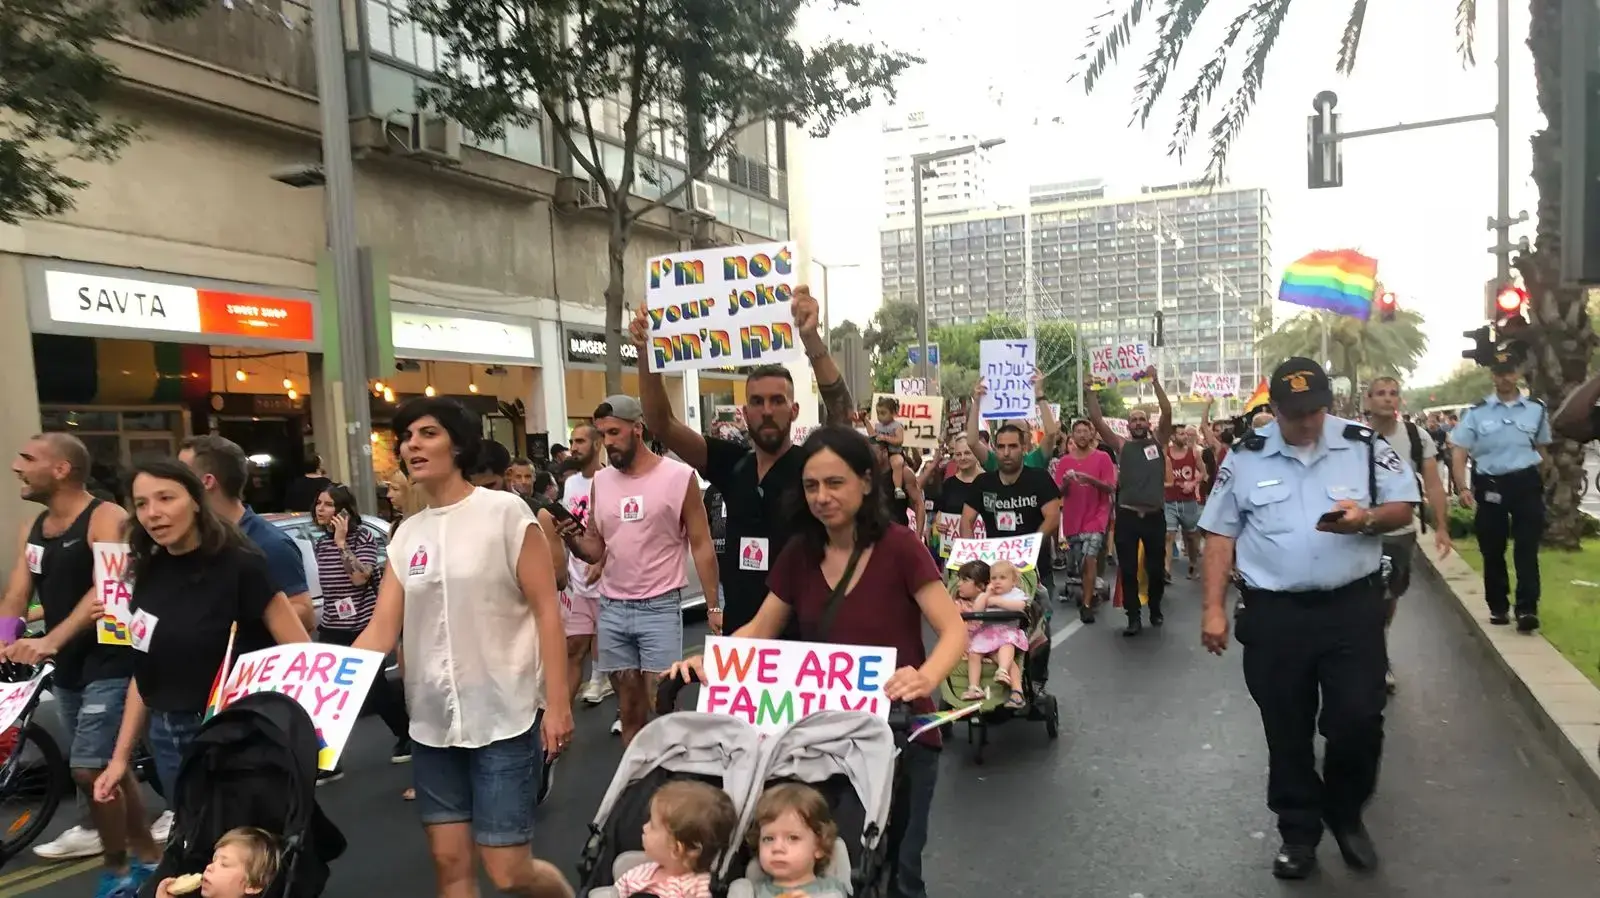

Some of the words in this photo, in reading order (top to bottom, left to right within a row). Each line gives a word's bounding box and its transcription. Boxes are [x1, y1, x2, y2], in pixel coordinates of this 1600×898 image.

[723, 246, 792, 281] not
[78, 286, 167, 318] SAVTA
[648, 297, 716, 331] your
[728, 283, 793, 316] joke
[739, 322, 794, 360] תקן
[1005, 343, 1028, 358] די
[1092, 347, 1113, 361] WE
[1117, 343, 1145, 358] ARE
[988, 360, 1034, 376] לשלוח
[1093, 355, 1147, 373] FAMILY!
[988, 378, 1032, 391] אותנו
[1195, 373, 1212, 383] WE
[1215, 375, 1236, 385] ARE
[983, 494, 1038, 509] Breaking
[960, 541, 991, 551] WE
[996, 537, 1035, 551] ARE
[957, 549, 1033, 561] FAMILY!
[101, 551, 133, 579] W
[235, 654, 281, 688] WE
[281, 651, 364, 685] ARE
[712, 644, 781, 684] WE
[795, 650, 882, 691] ARE
[221, 684, 349, 721] FILY!
